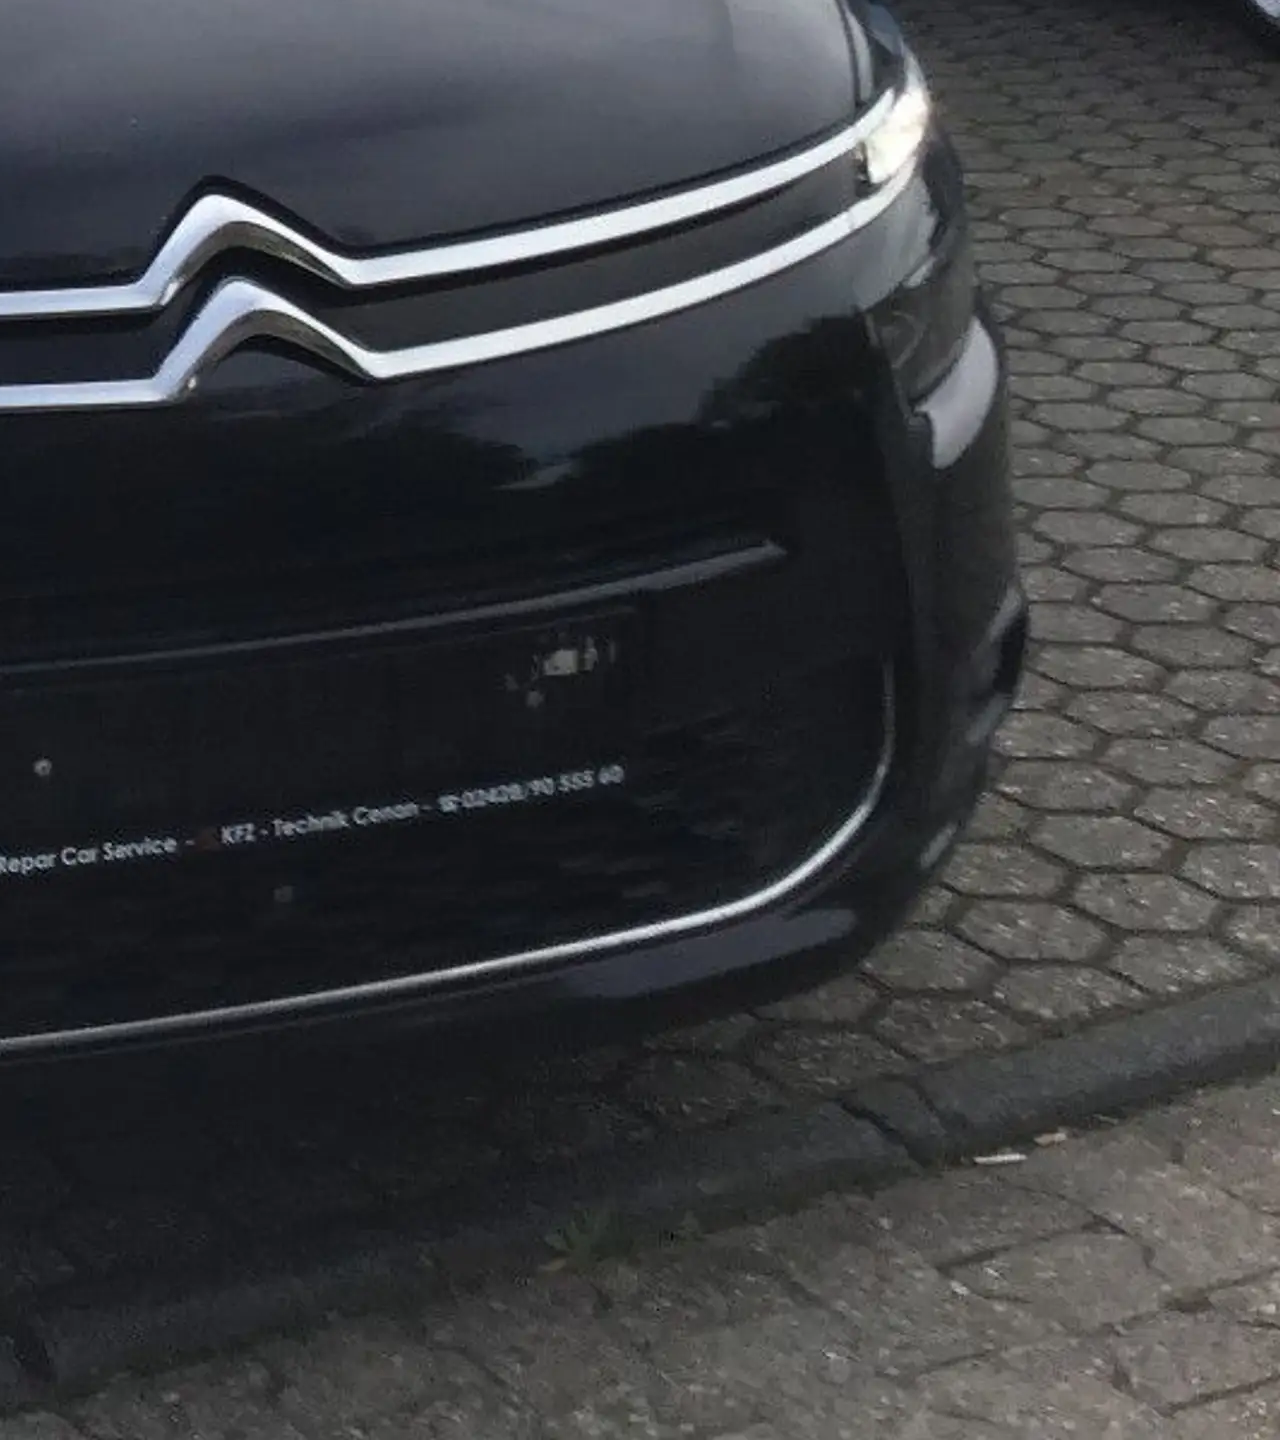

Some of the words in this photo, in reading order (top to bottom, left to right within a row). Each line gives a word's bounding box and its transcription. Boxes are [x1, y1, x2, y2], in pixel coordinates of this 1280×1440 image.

[61, 846, 98, 867] Car
[102, 836, 178, 862] Service
[272, 810, 349, 836] Technik
